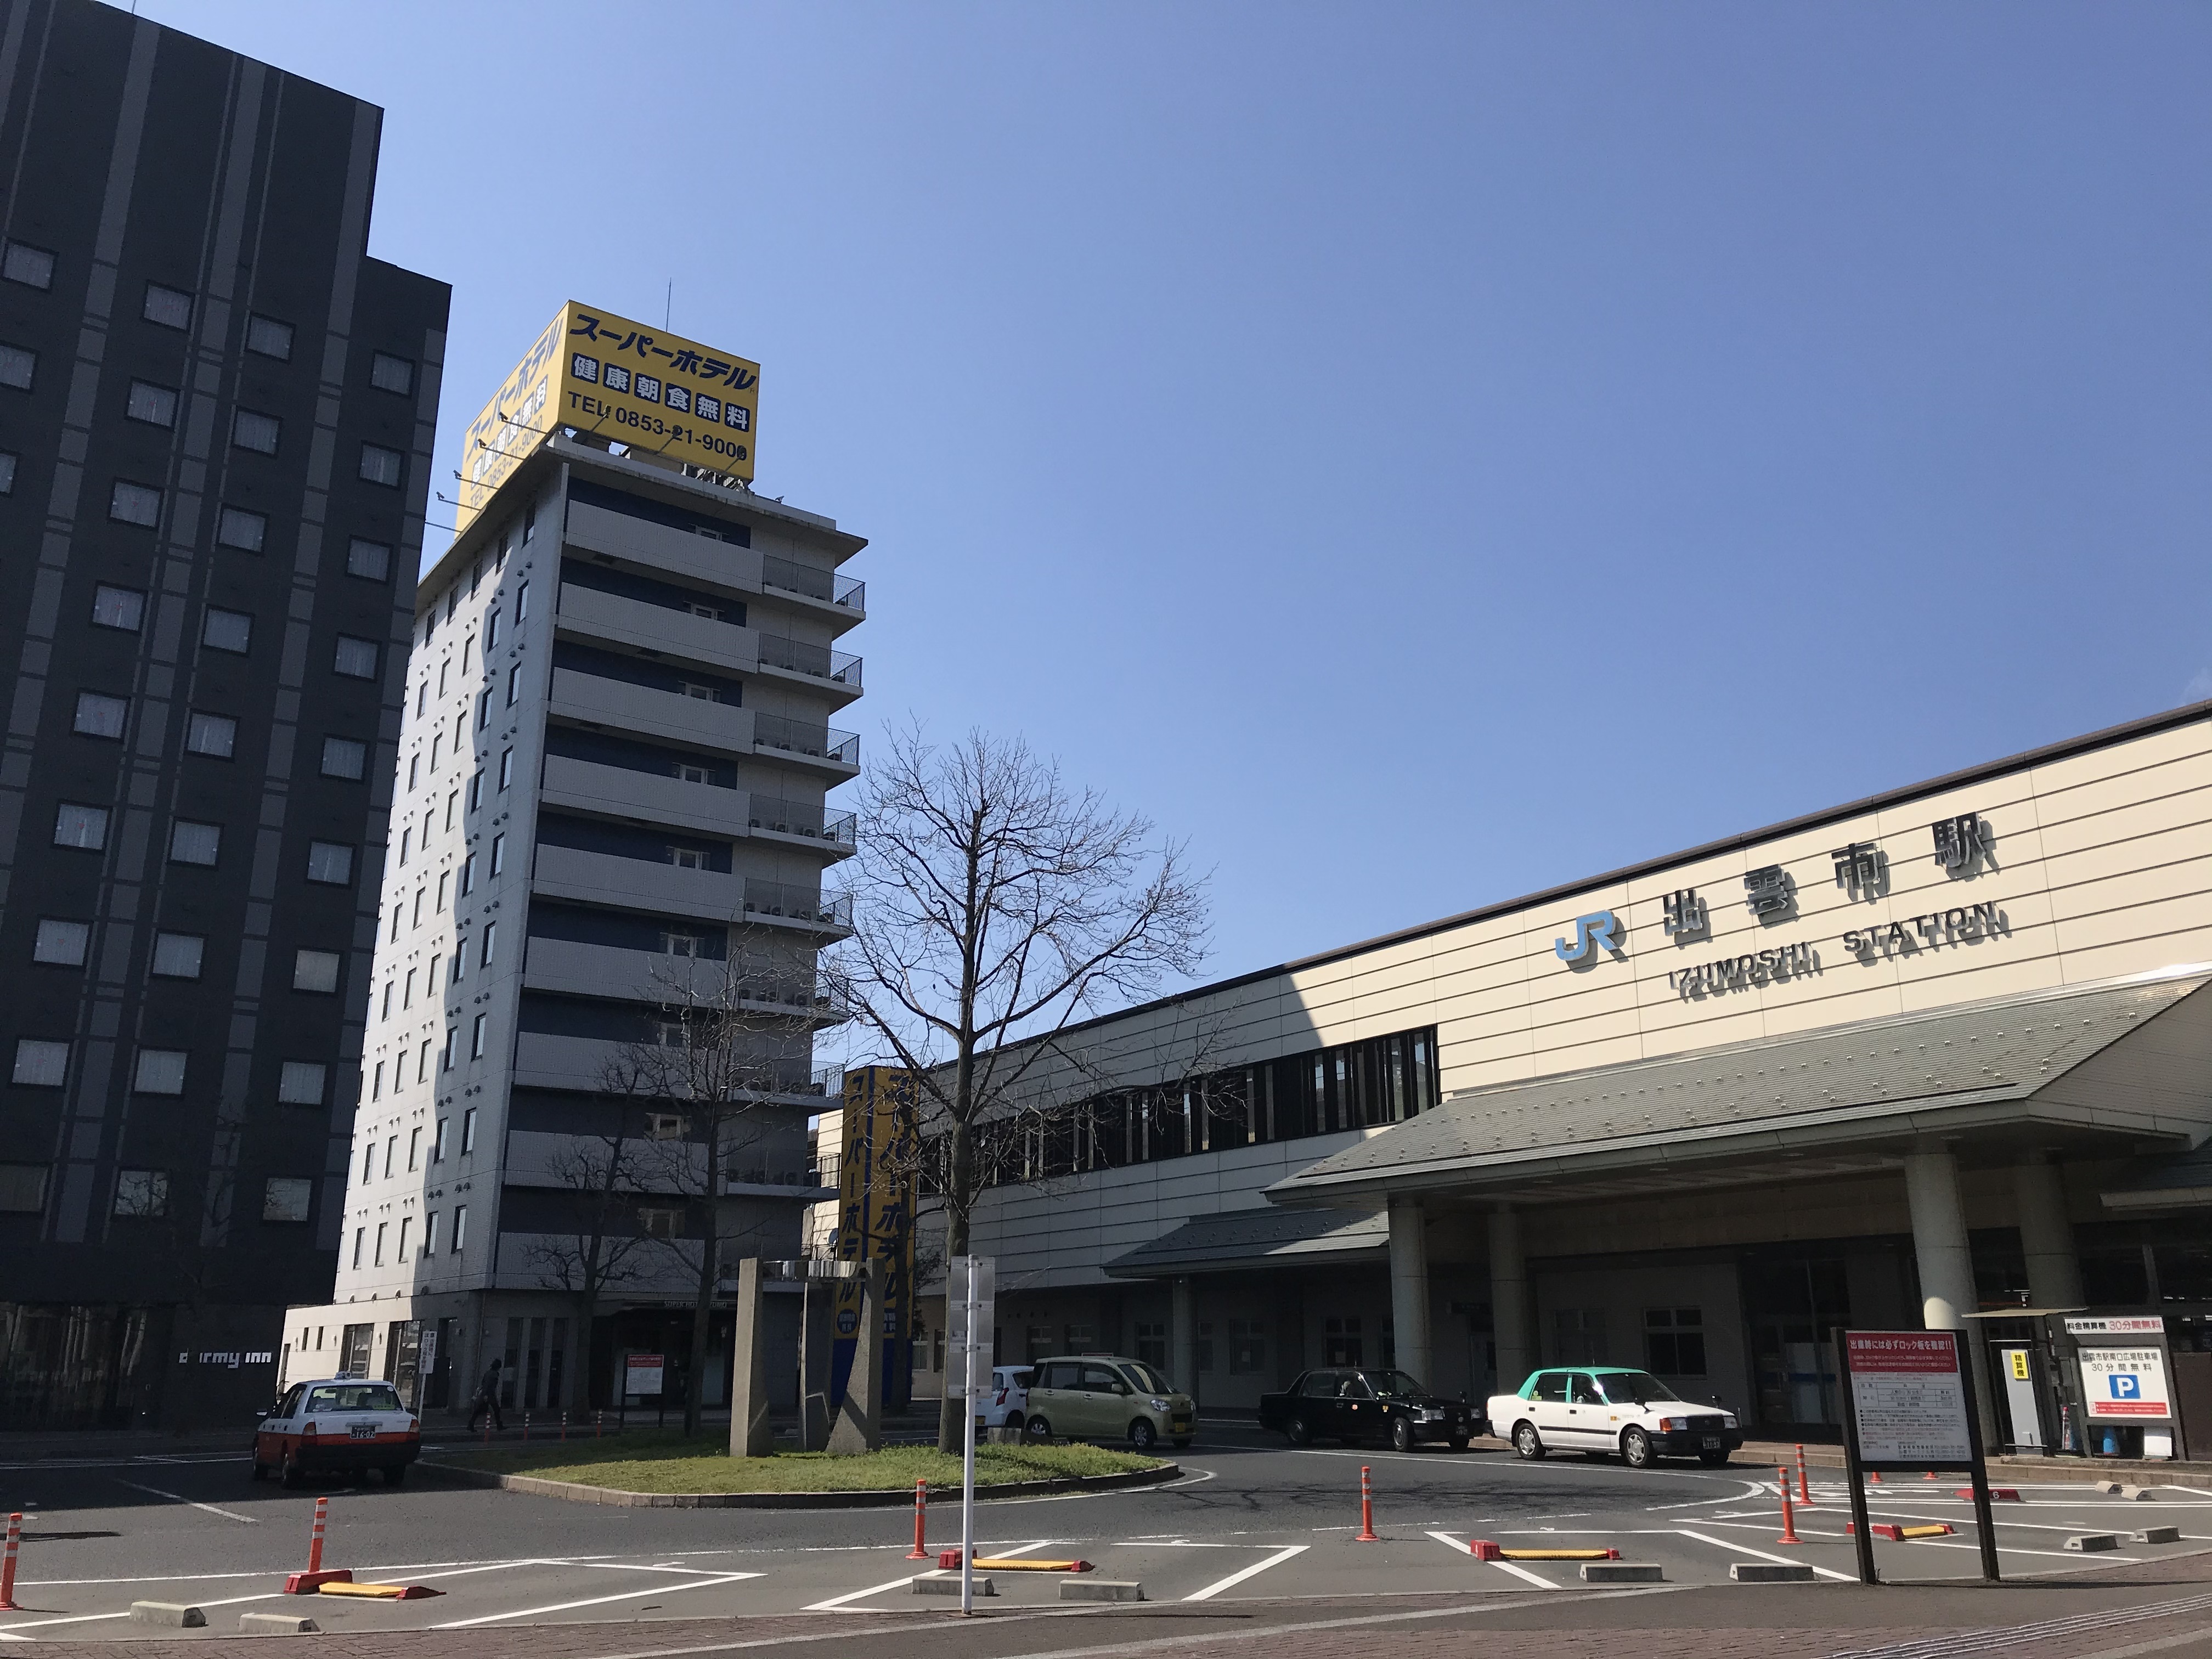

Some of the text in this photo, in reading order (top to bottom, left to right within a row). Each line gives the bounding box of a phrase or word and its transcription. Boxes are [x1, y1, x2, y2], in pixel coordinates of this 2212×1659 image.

[569, 314, 757, 390] スーパーホテル
[466, 317, 564, 463] スーパーホテル
[573, 356, 749, 430] 健康朝食無料
[568, 391, 748, 461] TEL 0853-21-9000
[1662, 811, 1988, 937] 出雲市駅
[1555, 909, 1620, 962] JR
[1668, 900, 1999, 991] IZUMOSHI STATION
[839, 1075, 865, 1304] スーパーホテル
[245, 1352, 272, 1363] inn
[2067, 1321, 2161, 1330] 料金精算機 30分間無料
[2082, 1352, 2158, 1361] 出雲市駅南口広場駐車場
[2015, 1355, 2025, 1377] 精算機
[2117, 1378, 2134, 1397] P
